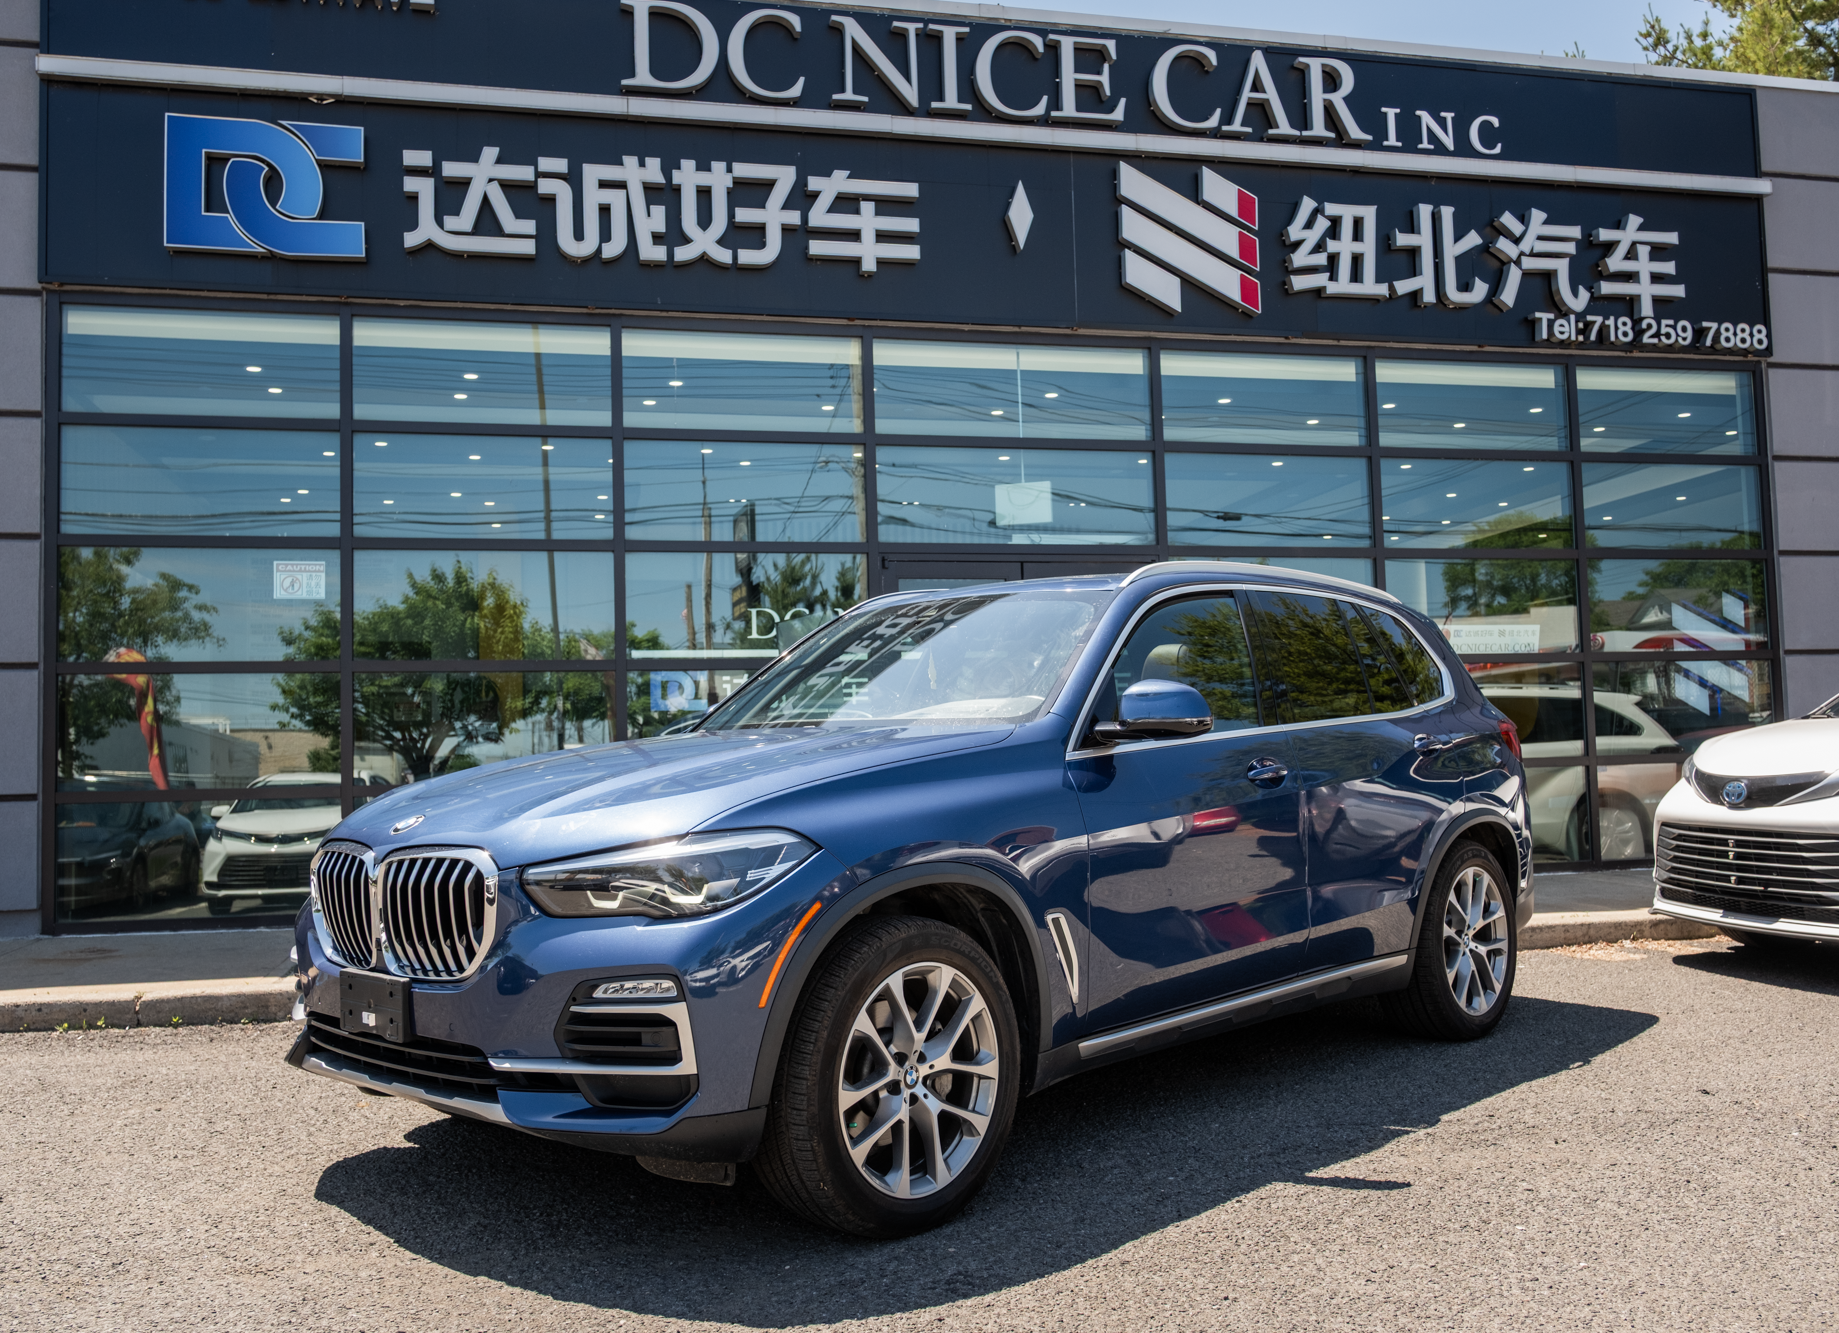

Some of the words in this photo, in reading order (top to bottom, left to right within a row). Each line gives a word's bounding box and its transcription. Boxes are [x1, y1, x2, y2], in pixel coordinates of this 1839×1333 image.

[620, 0, 806, 103] DC
[829, 15, 1127, 127] NICE
[1148, 44, 1373, 145] CAR
[1381, 106, 1502, 156] INC
[164, 112, 366, 262] DC
[402, 146, 921, 277] 达诚好车
[1284, 195, 1687, 318] 纽北汽车
[1642, 318, 1693, 346] 259
[1701, 321, 1769, 350] 7888
